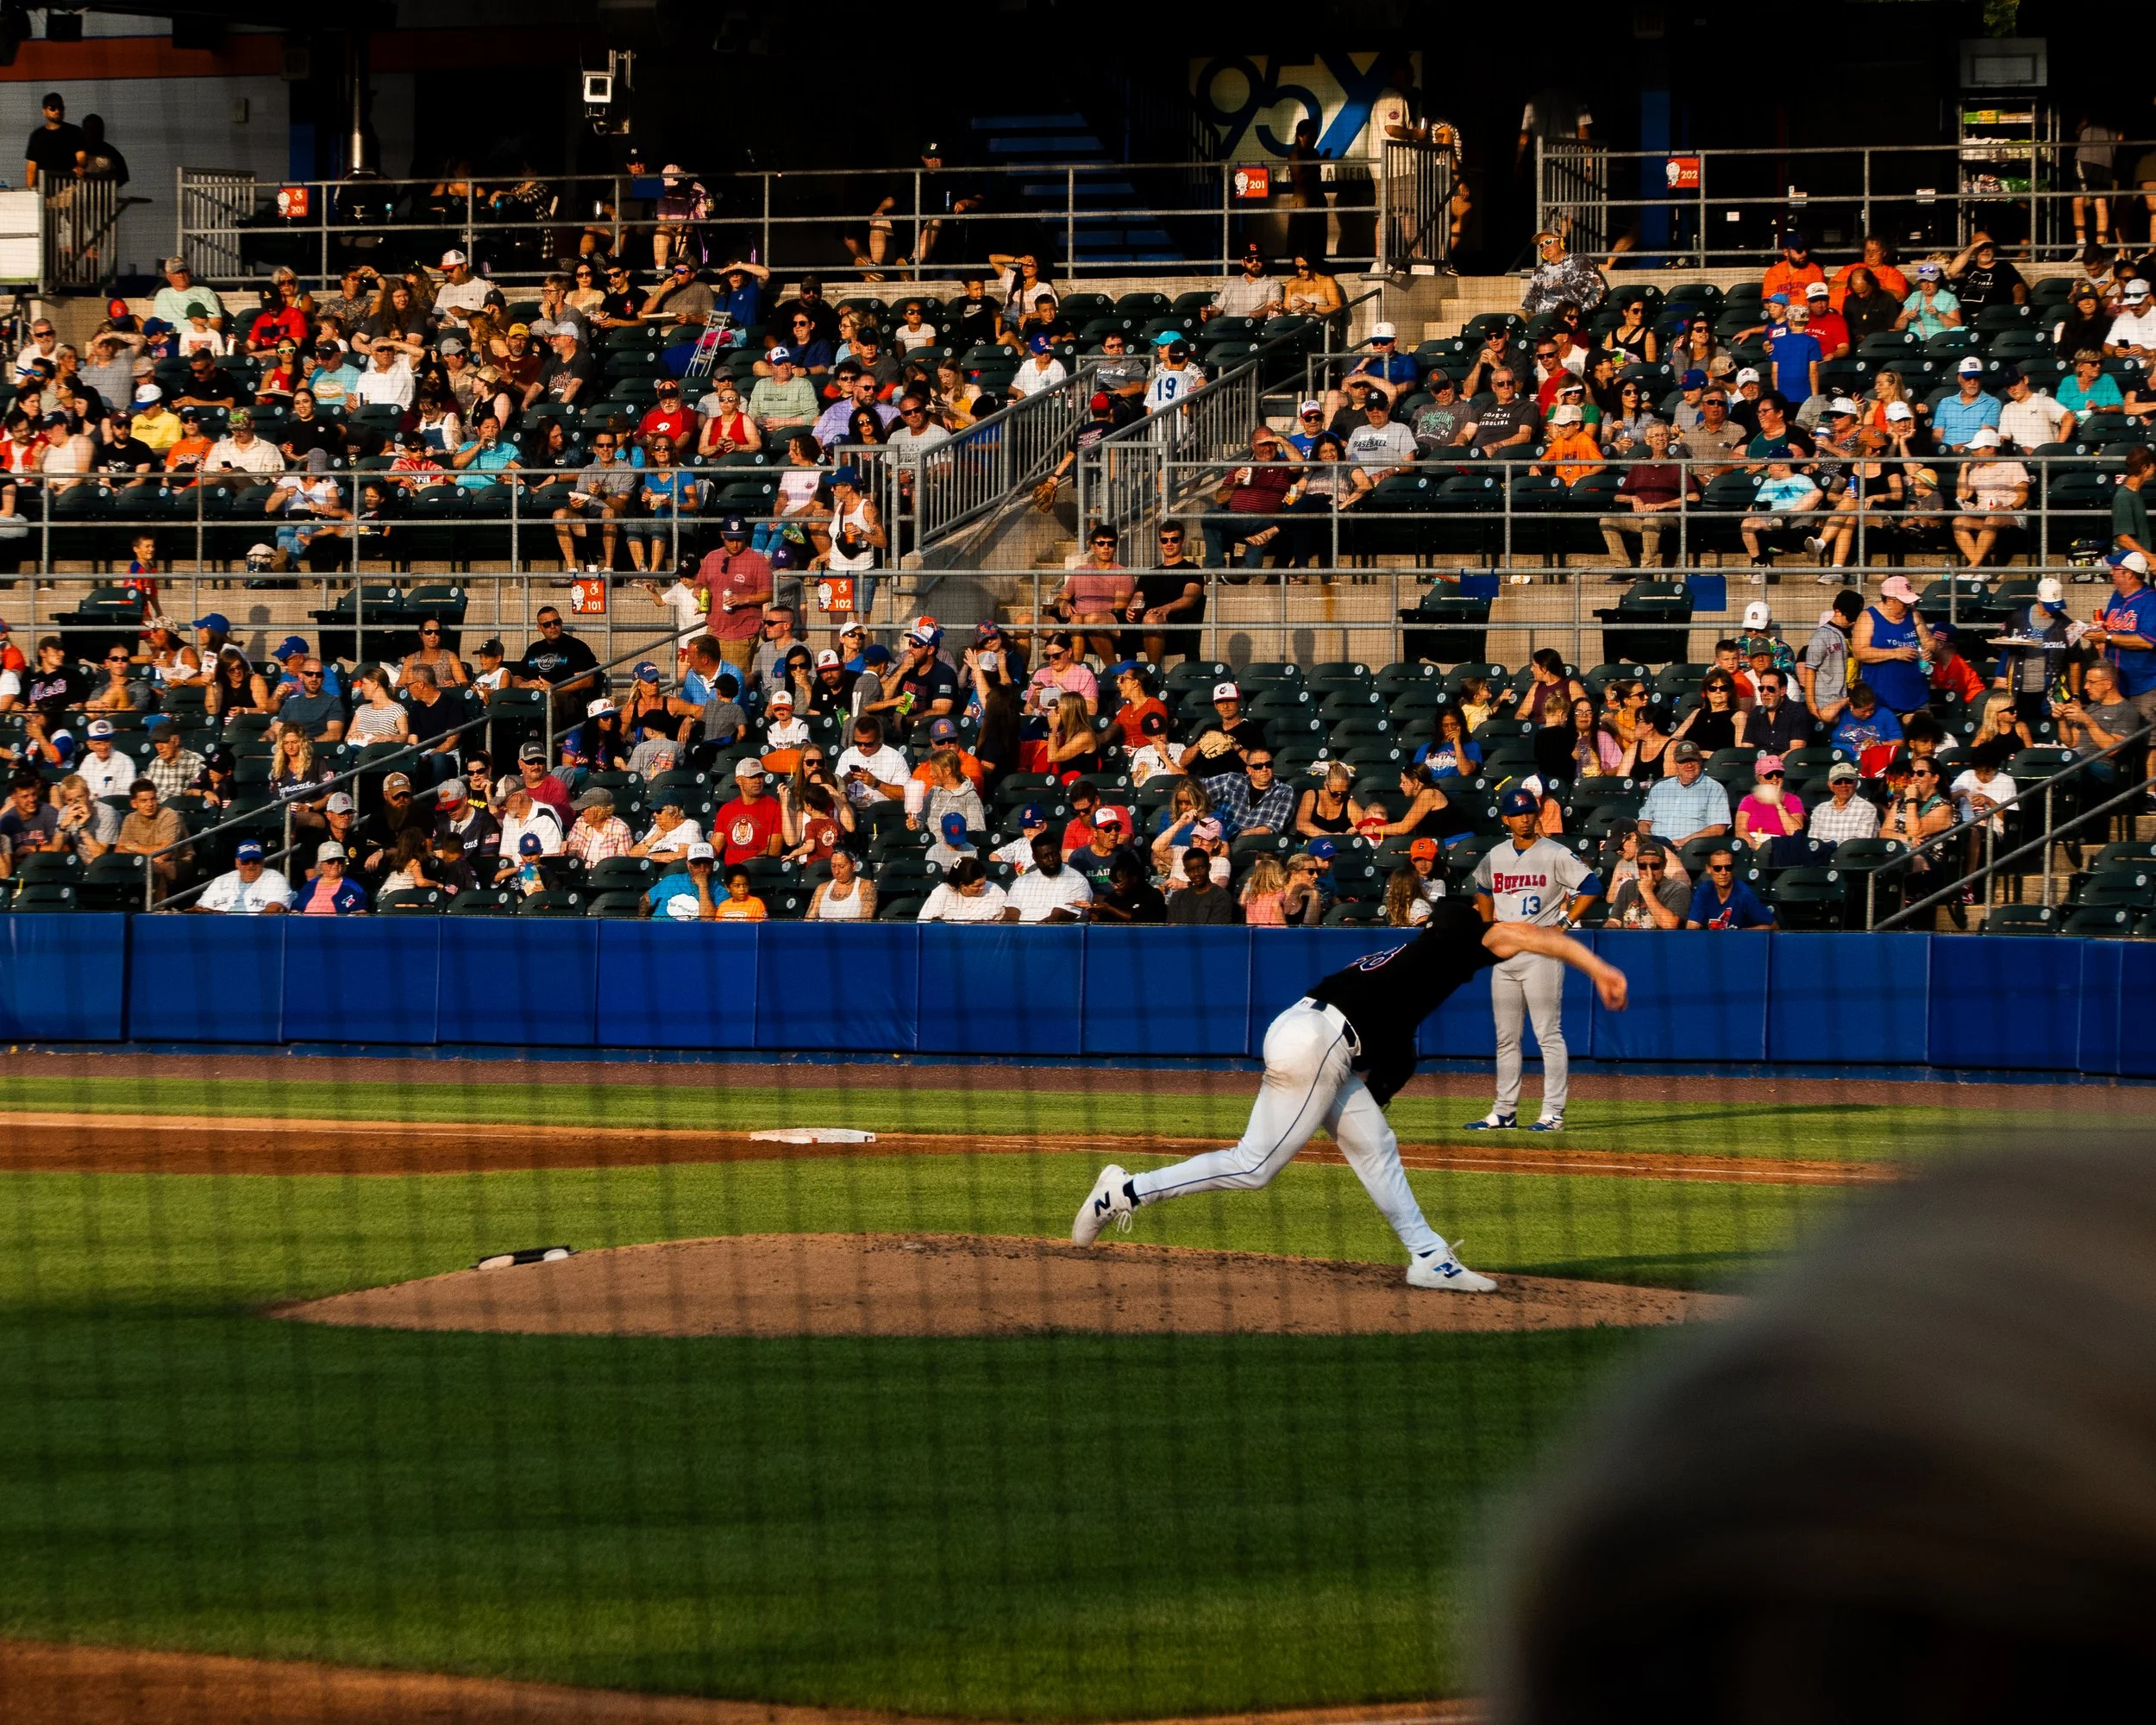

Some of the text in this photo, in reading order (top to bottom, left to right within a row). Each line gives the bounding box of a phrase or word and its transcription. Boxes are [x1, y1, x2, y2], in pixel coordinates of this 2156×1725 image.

[1196, 51, 1387, 160] 95X
[1681, 170, 1697, 179] 202
[1250, 180, 1265, 189] 201
[291, 205, 304, 214] 201
[1157, 377, 1177, 401] 19
[1370, 392, 1378, 400] NY
[587, 601, 601, 611] 101
[835, 599, 851, 609] 102
[28, 678, 66, 703] Mets
[1493, 872, 1547, 894] BUFFALO
[1521, 895, 1541, 916] 13
[1094, 1190, 1111, 1218] N
